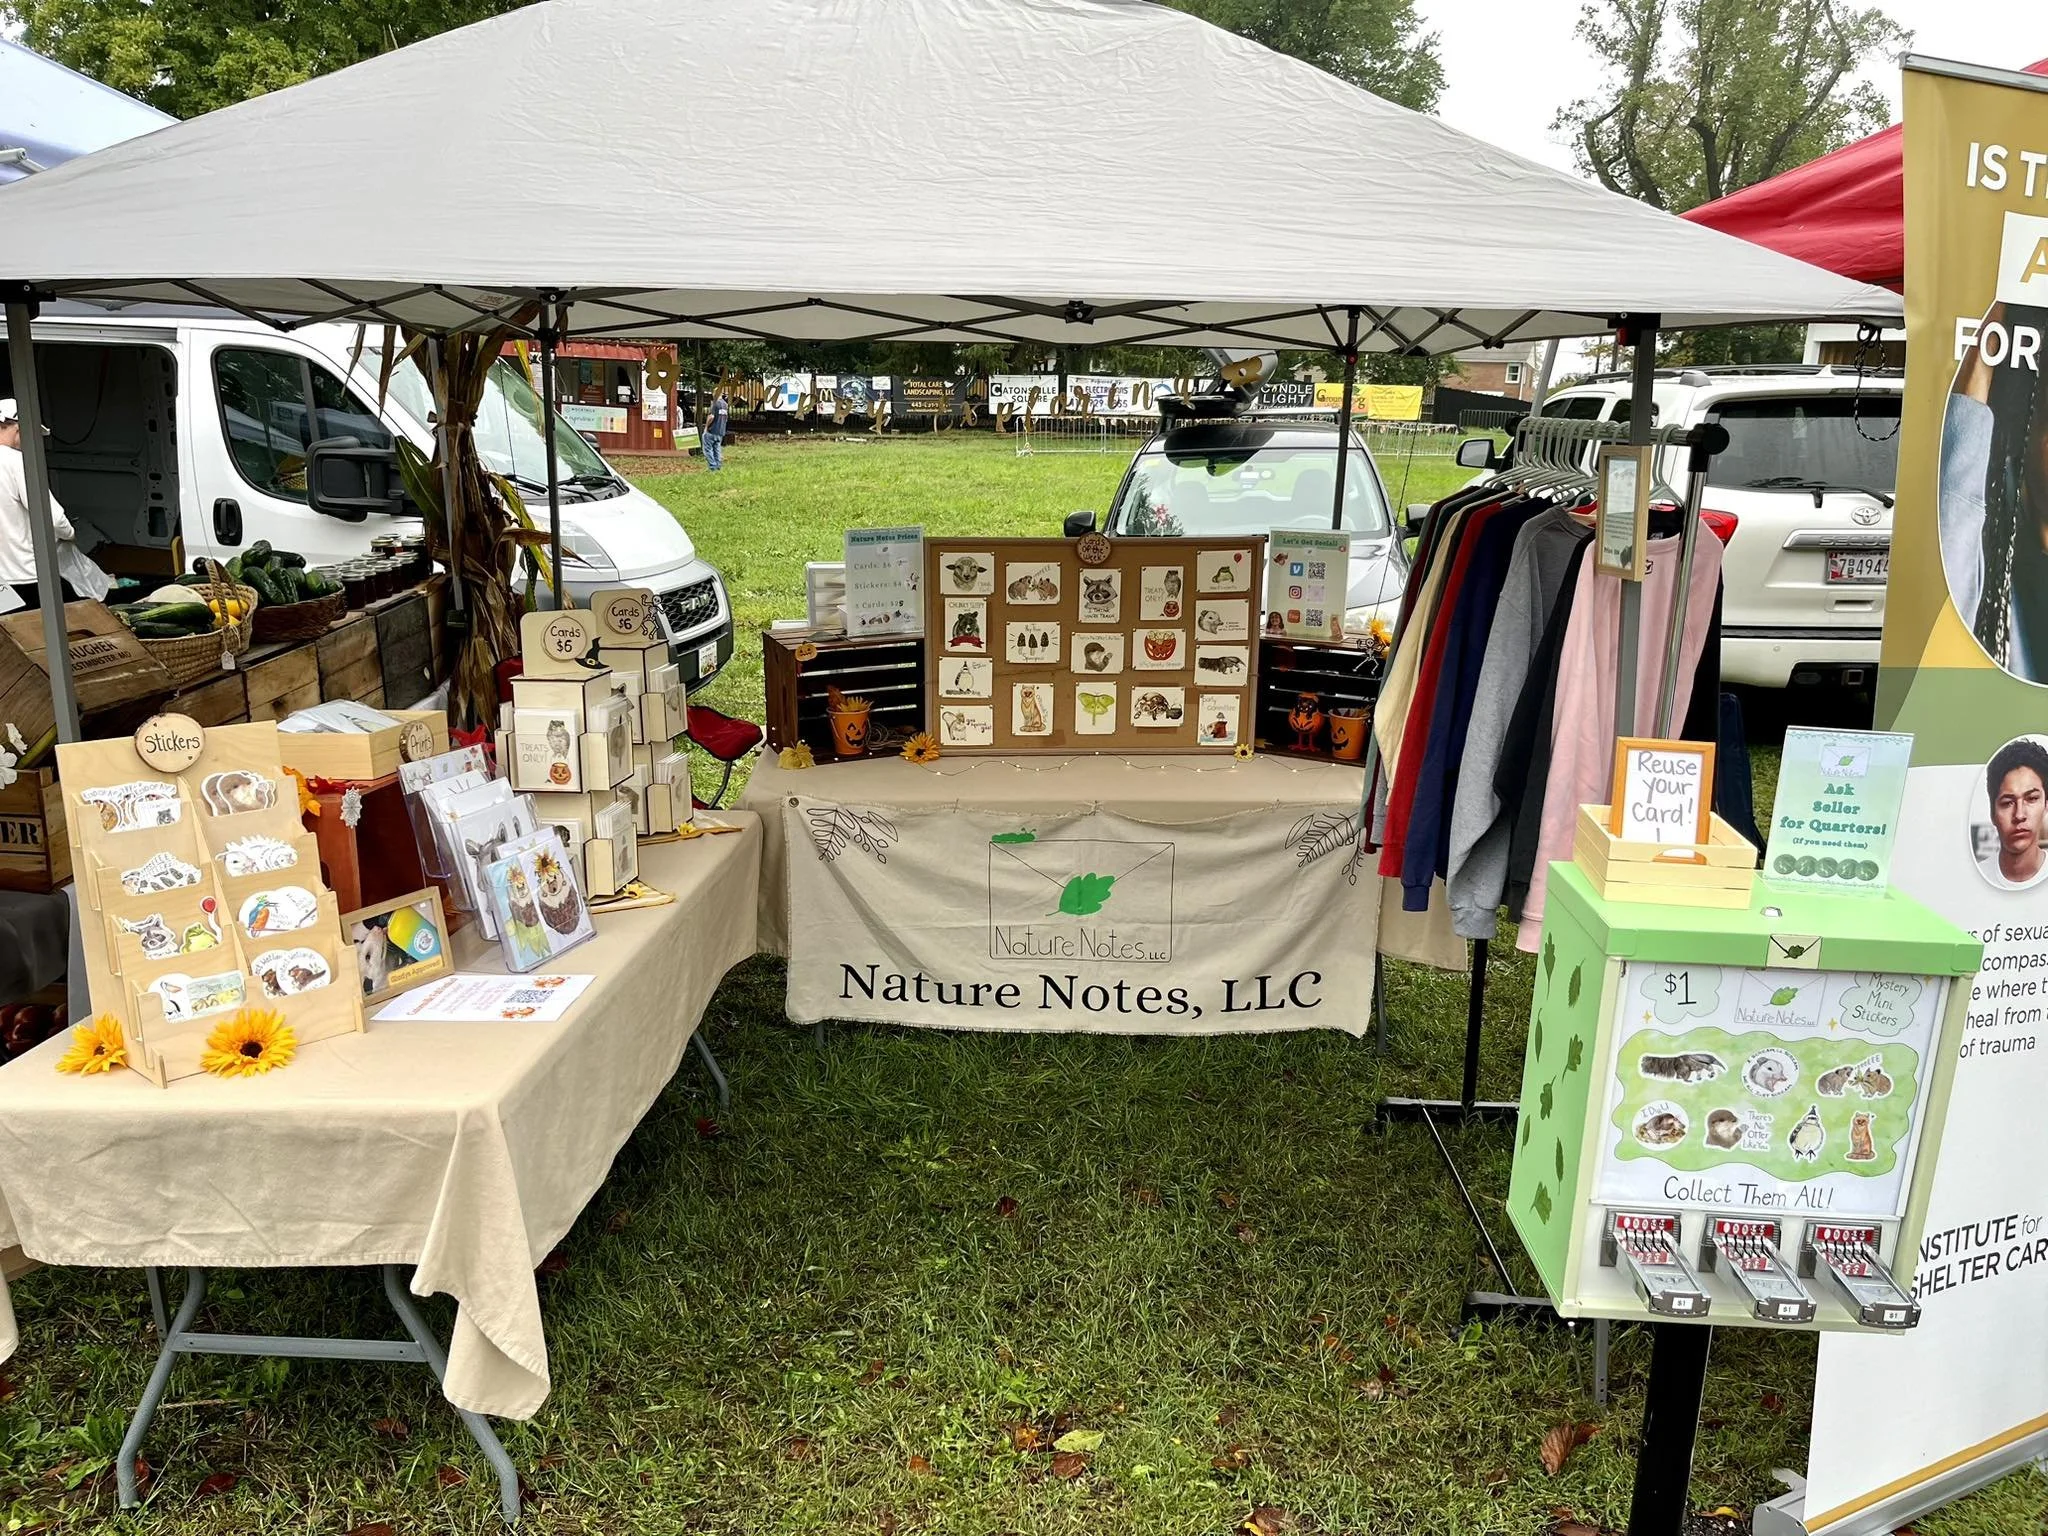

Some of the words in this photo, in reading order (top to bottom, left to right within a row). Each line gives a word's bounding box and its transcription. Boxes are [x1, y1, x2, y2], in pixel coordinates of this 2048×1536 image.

[1966, 142, 2009, 191] IS
[2020, 151, 2048, 199] T
[1954, 316, 2041, 372] FOR
[991, 383, 1056, 397] CATONSILLE
[1263, 393, 1306, 404] LIGHT
[611, 606, 640, 617] Cards
[550, 625, 581, 638] Cards
[618, 618, 633, 630] $6
[68, 640, 118, 660] AUGHER
[556, 639, 573, 653] $6
[144, 731, 201, 753] Stickers
[1638, 750, 1697, 776] Reuse
[1824, 783, 1855, 796] Ask
[1812, 800, 1861, 815] Seller
[1779, 815, 1805, 829] for
[1809, 818, 1887, 836] Quarters!
[995, 925, 1075, 956] Nature
[1149, 951, 1166, 960] LLC
[1982, 923, 2001, 943] of
[1982, 953, 2048, 972] compas
[839, 963, 1021, 1010] Nature
[1038, 974, 1204, 1020] Notes,
[1220, 971, 1323, 1014] LLC
[1664, 972, 1697, 1005] $1
[1986, 979, 2036, 999] where
[1736, 1007, 1775, 1023] Nature
[1852, 1005, 1898, 1026] Stickers
[1966, 1008, 1998, 1029] heal
[2004, 1006, 2041, 1025] from
[1960, 1038, 1976, 1058] of
[1979, 1035, 2036, 1056] trauma
[1663, 1175, 1733, 1203] Collect
[1738, 1182, 1787, 1207] Them
[1794, 1184, 1834, 1210] All!
[1916, 1214, 2018, 1265] NSTITUTE
[2022, 1214, 2043, 1236] for
